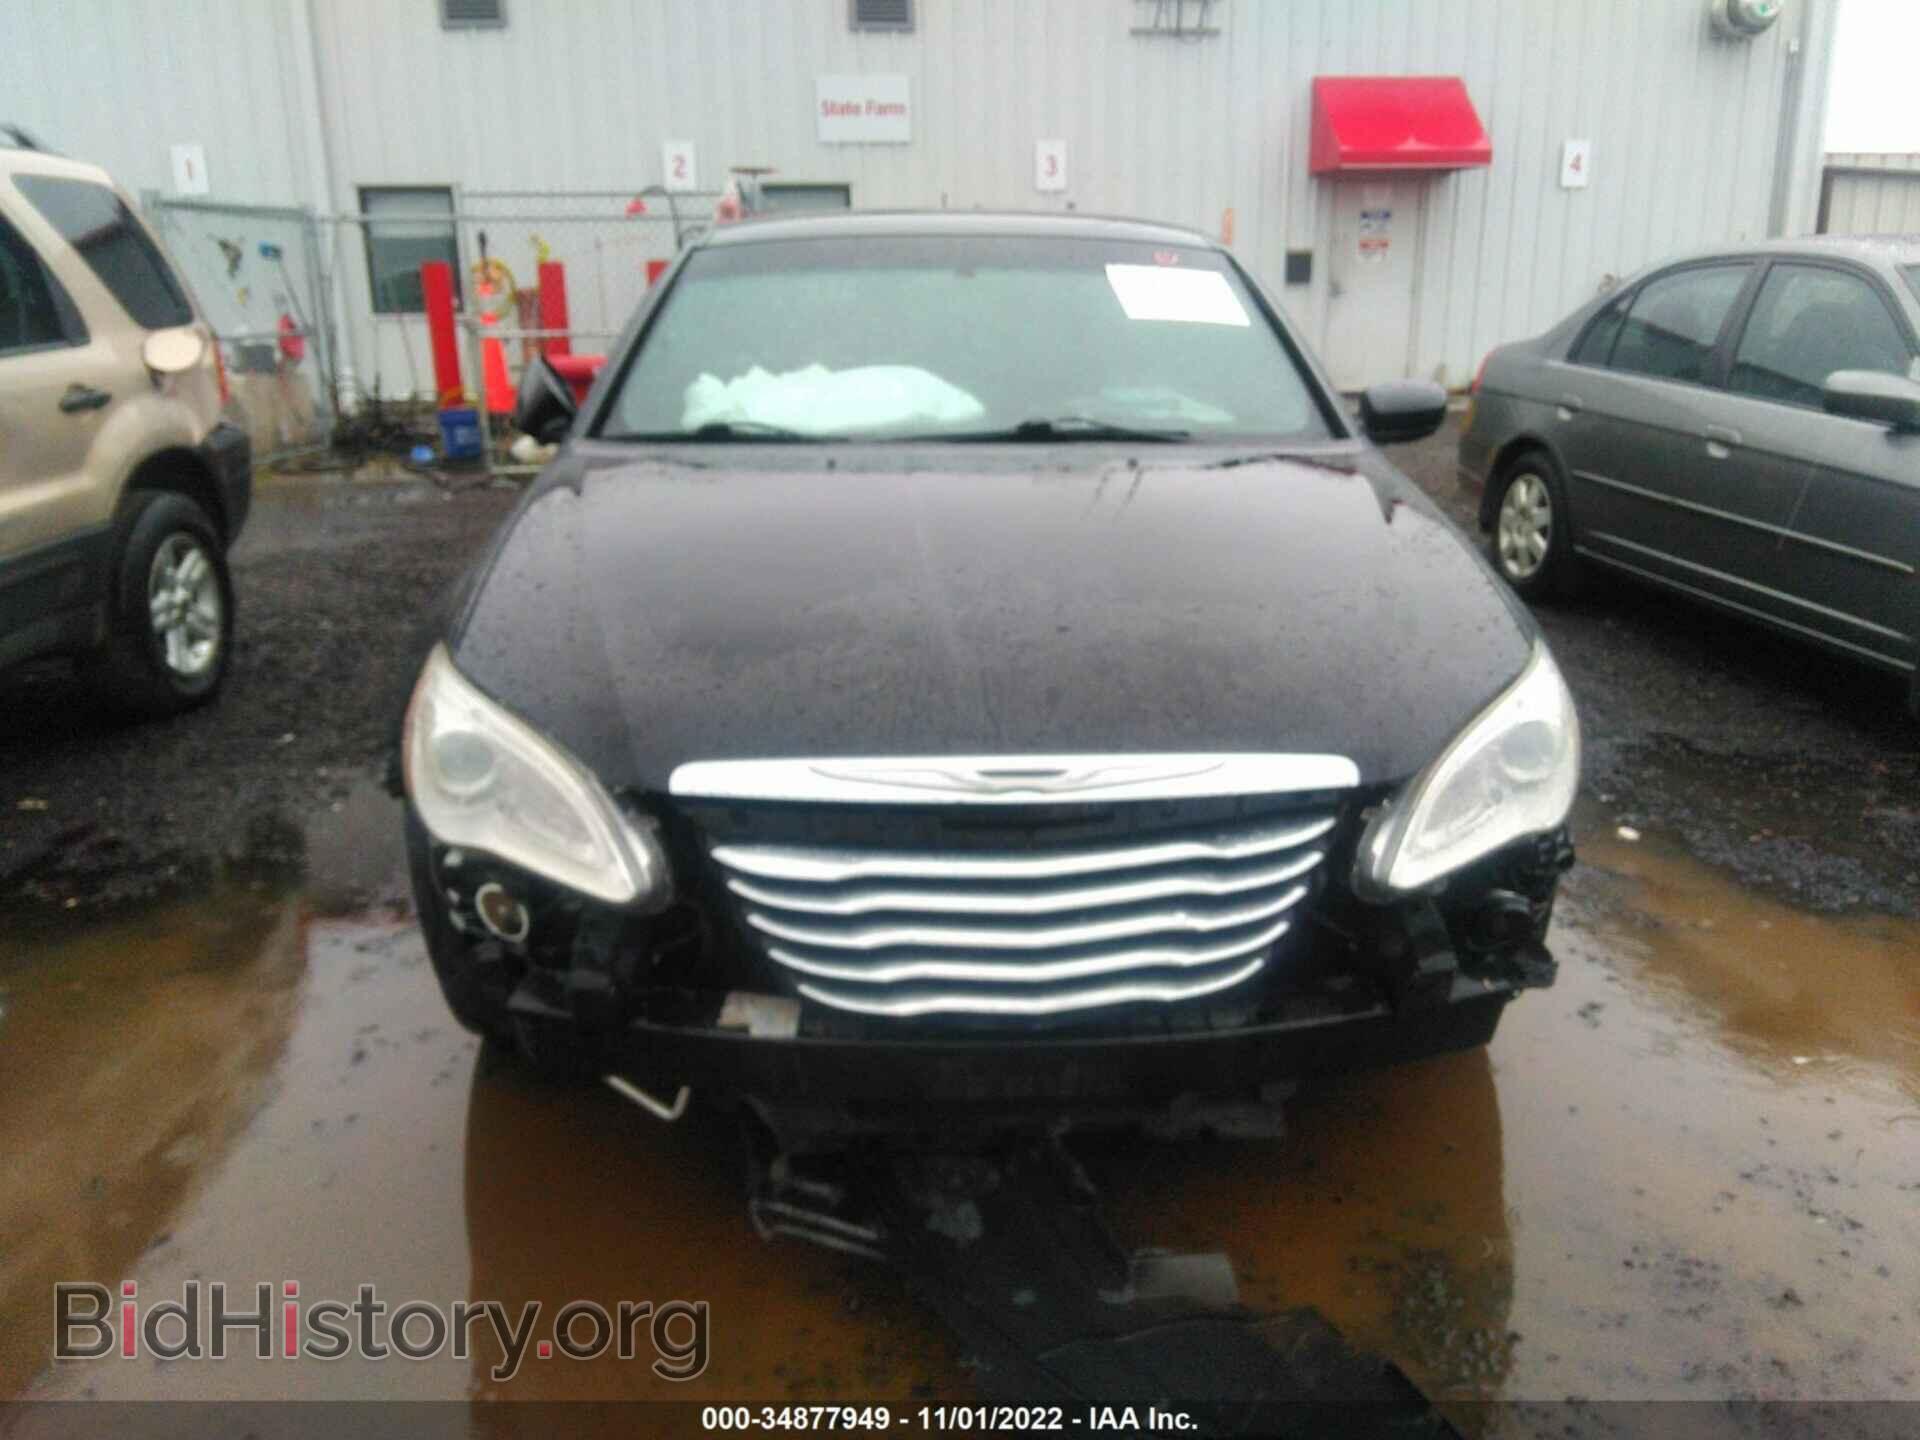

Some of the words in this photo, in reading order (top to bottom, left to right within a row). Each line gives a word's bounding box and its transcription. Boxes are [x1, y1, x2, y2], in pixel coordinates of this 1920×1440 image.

[821, 99, 861, 118] State
[864, 99, 907, 117] Farm
[672, 154, 687, 180] 2
[1044, 154, 1058, 178] 3
[1568, 152, 1582, 174] 4
